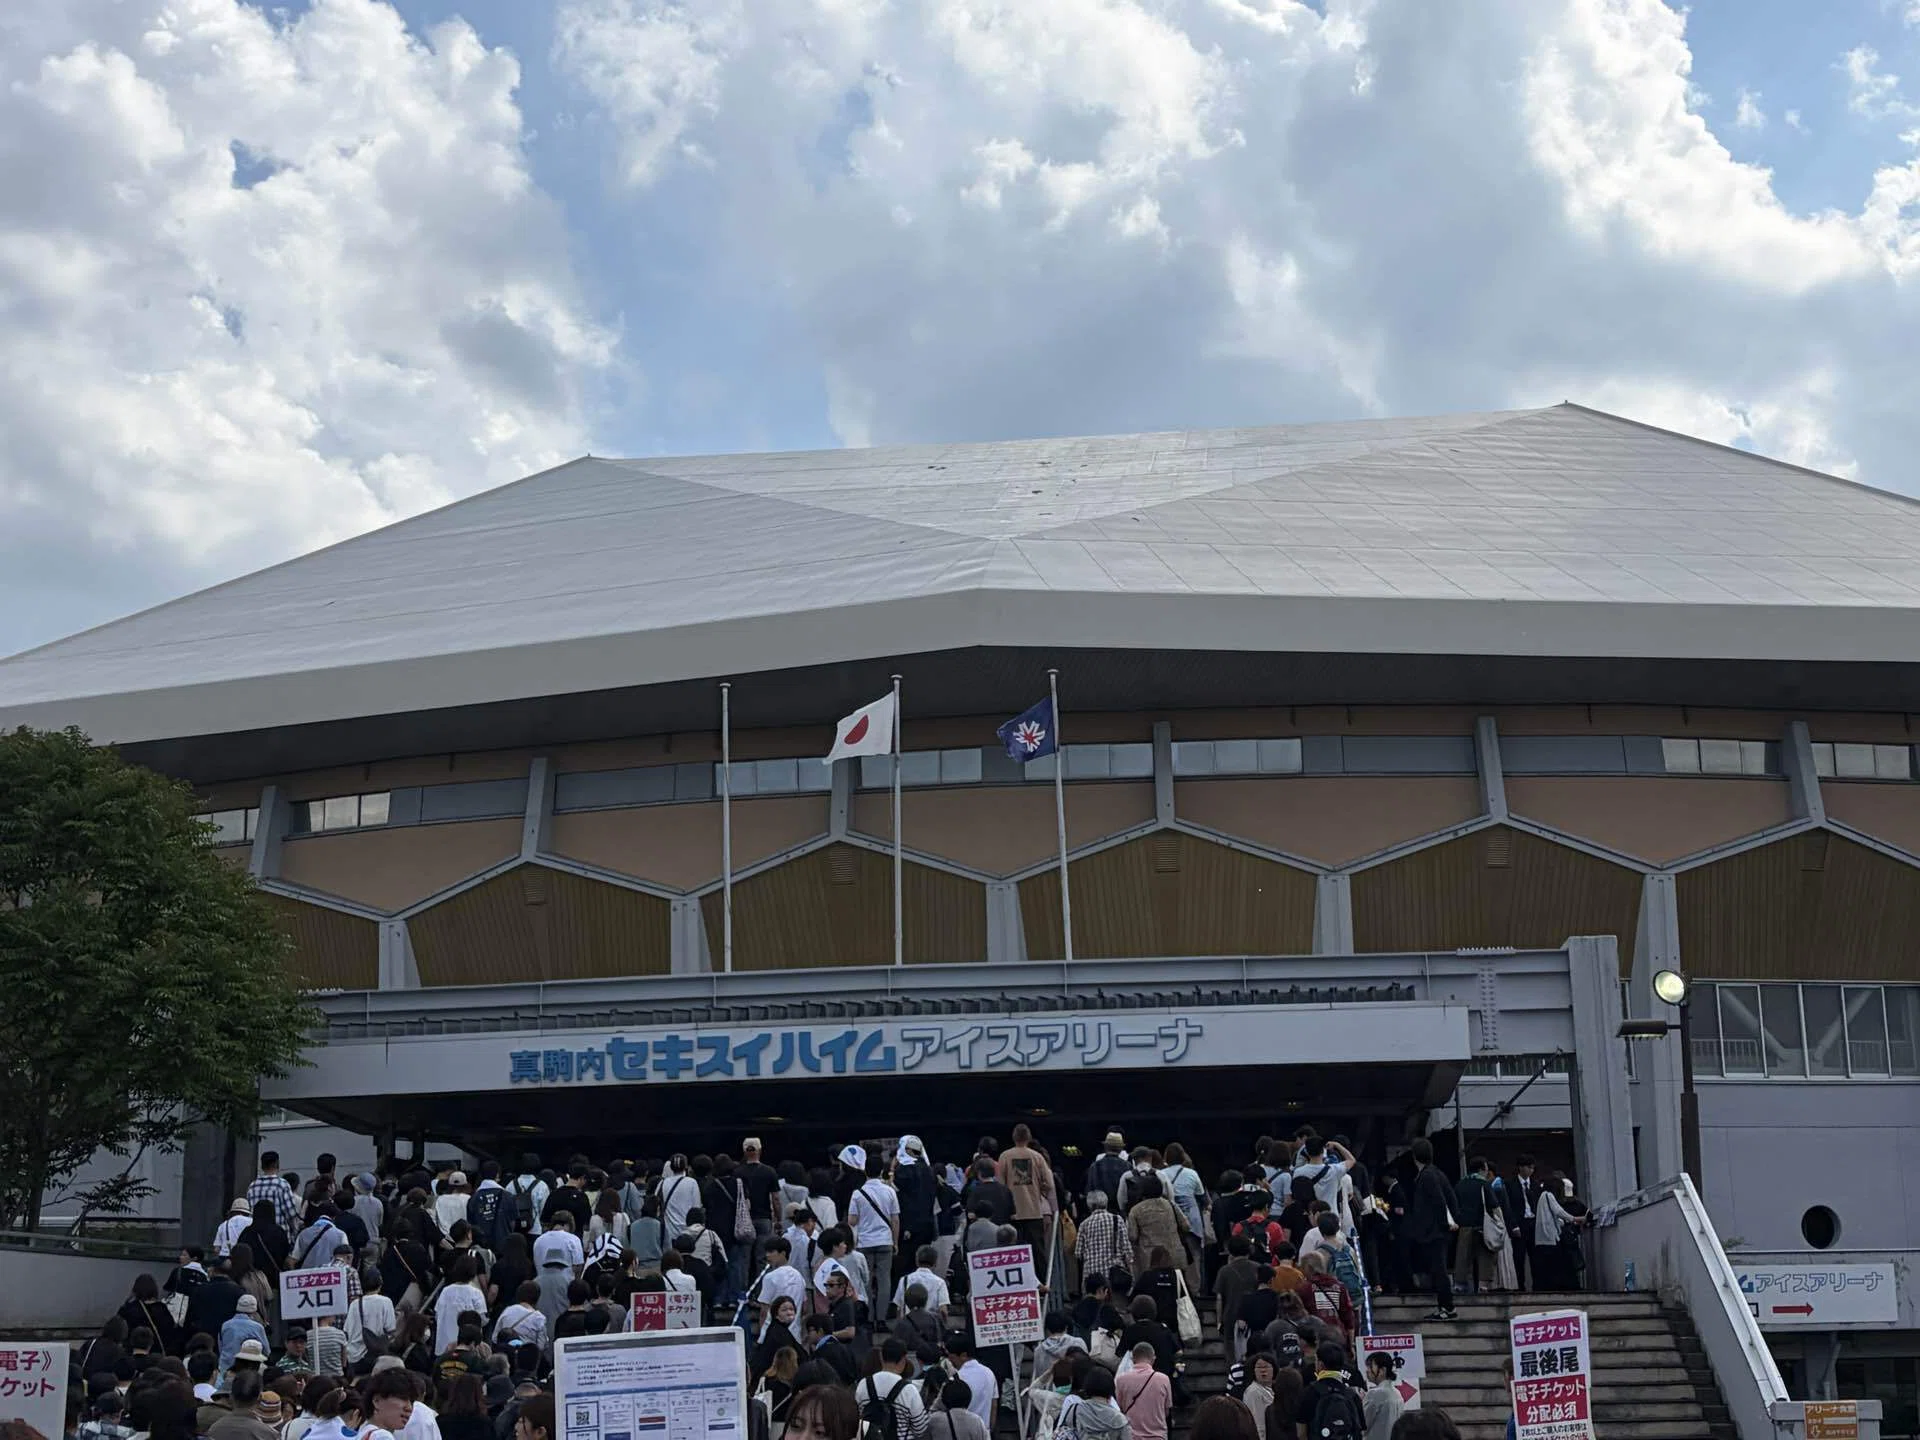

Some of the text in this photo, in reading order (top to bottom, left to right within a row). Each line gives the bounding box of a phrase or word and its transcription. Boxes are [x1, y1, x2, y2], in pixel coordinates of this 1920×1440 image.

[509, 1018, 1203, 1084] 真駒内セキスイハイムアイスアリーナ
[987, 1267, 1023, 1289] 入口
[297, 1289, 334, 1309] 入口
[668, 1305, 696, 1314] チケット
[635, 1305, 665, 1315] チケット
[1514, 1322, 1579, 1342] 電子チケット
[1520, 1346, 1579, 1377] 最後尾
[0, 1377, 55, 1397] ケット
[1516, 1378, 1585, 1402] 電子チケット
[1526, 1401, 1577, 1423] 分配必須
